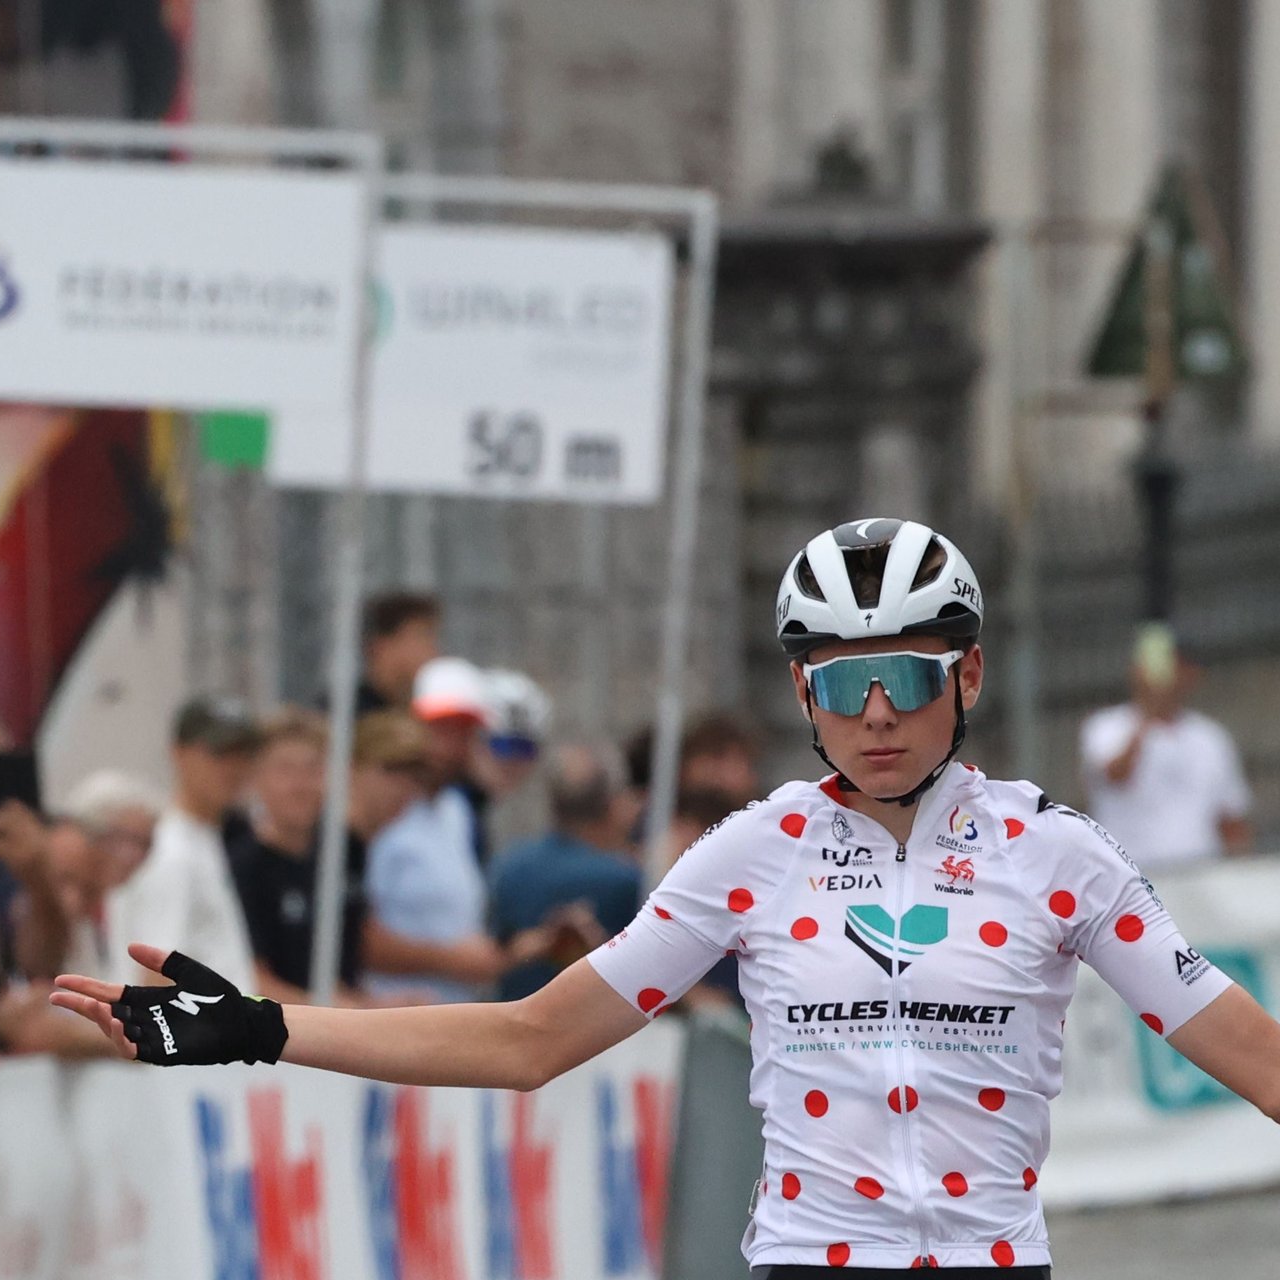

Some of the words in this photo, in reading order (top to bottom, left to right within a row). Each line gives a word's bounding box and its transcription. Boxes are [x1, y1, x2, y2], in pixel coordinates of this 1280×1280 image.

[468, 408, 542, 480] 50
[564, 432, 622, 482] m
[809, 874, 882, 891] VEDIA
[934, 882, 974, 896] Wallonie
[787, 1000, 888, 1023] CYCLES
[893, 1000, 1015, 1024] HENKET
[797, 1027, 825, 1036] SHOP
[786, 1042, 846, 1053] PEPINSTER
